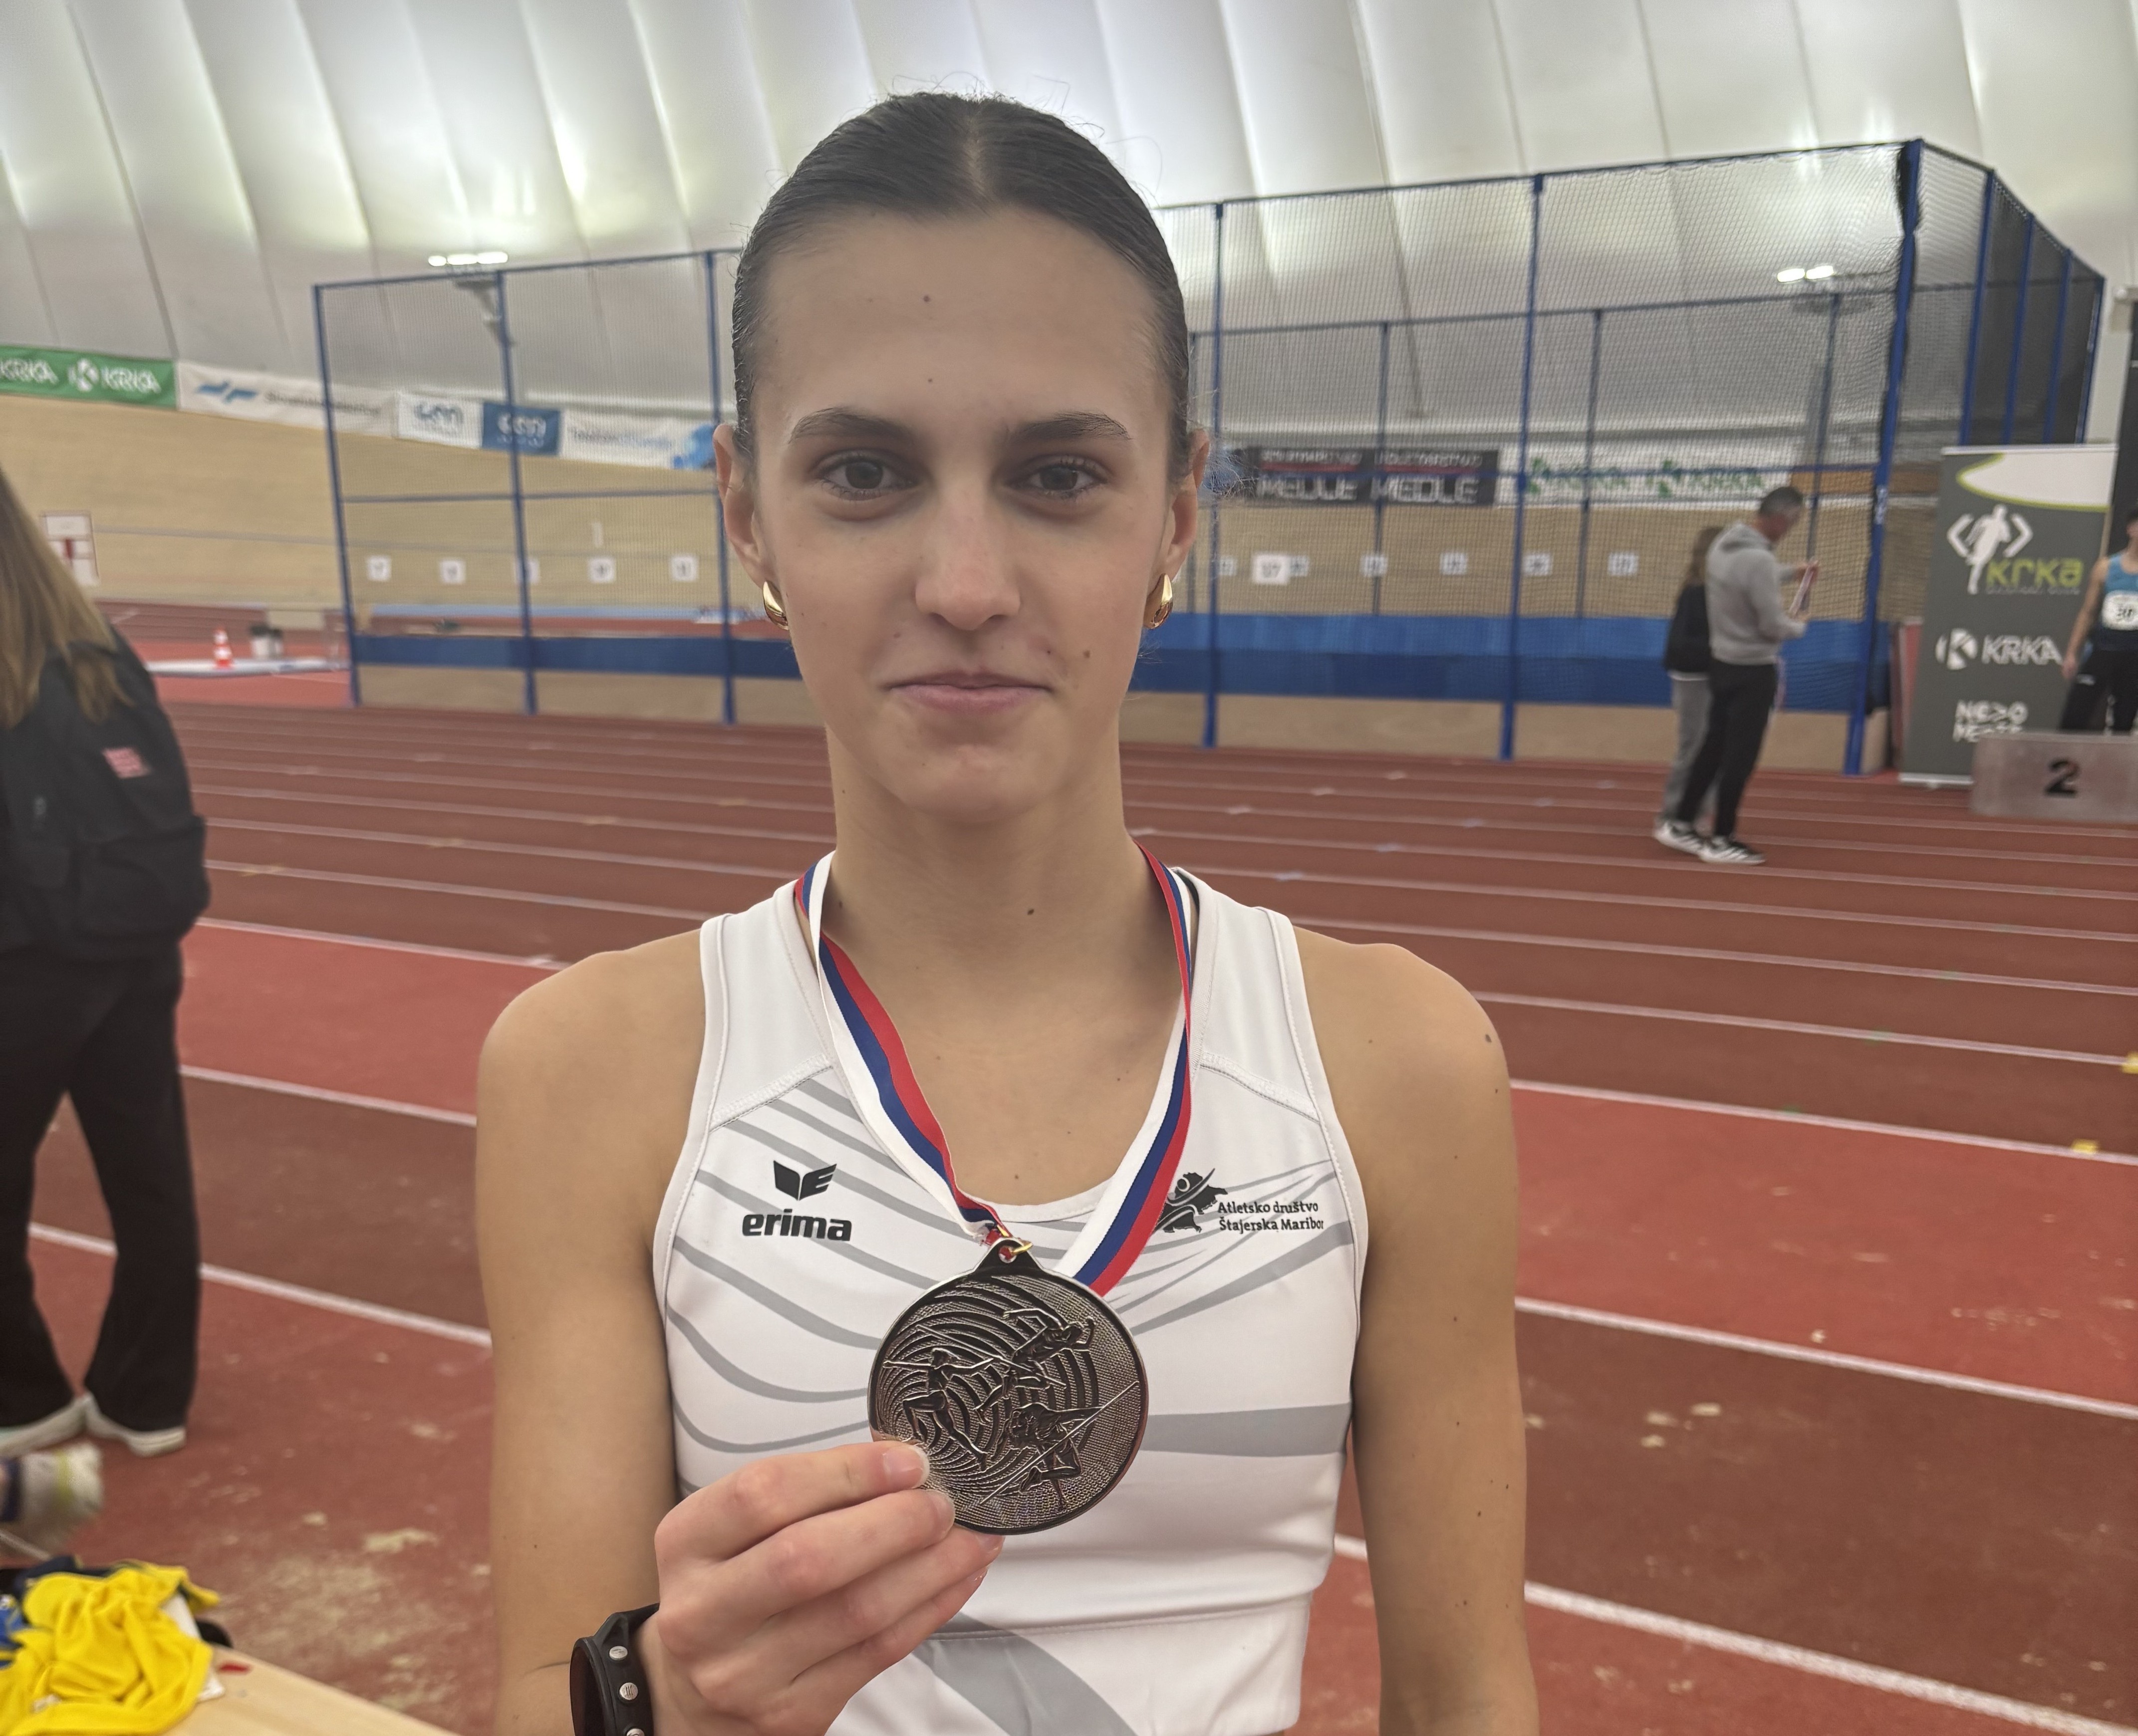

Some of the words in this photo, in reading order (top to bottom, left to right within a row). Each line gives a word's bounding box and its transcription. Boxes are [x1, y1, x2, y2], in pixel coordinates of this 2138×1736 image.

[1985, 557, 2084, 587] krka
[1981, 635, 2064, 665] KRKA
[2045, 756, 2080, 797] 2
[1218, 1201, 1271, 1214] Atletsko
[1273, 1201, 1318, 1214] društvo
[742, 1208, 852, 1241] erima
[1219, 1216, 1279, 1235] Štajerska
